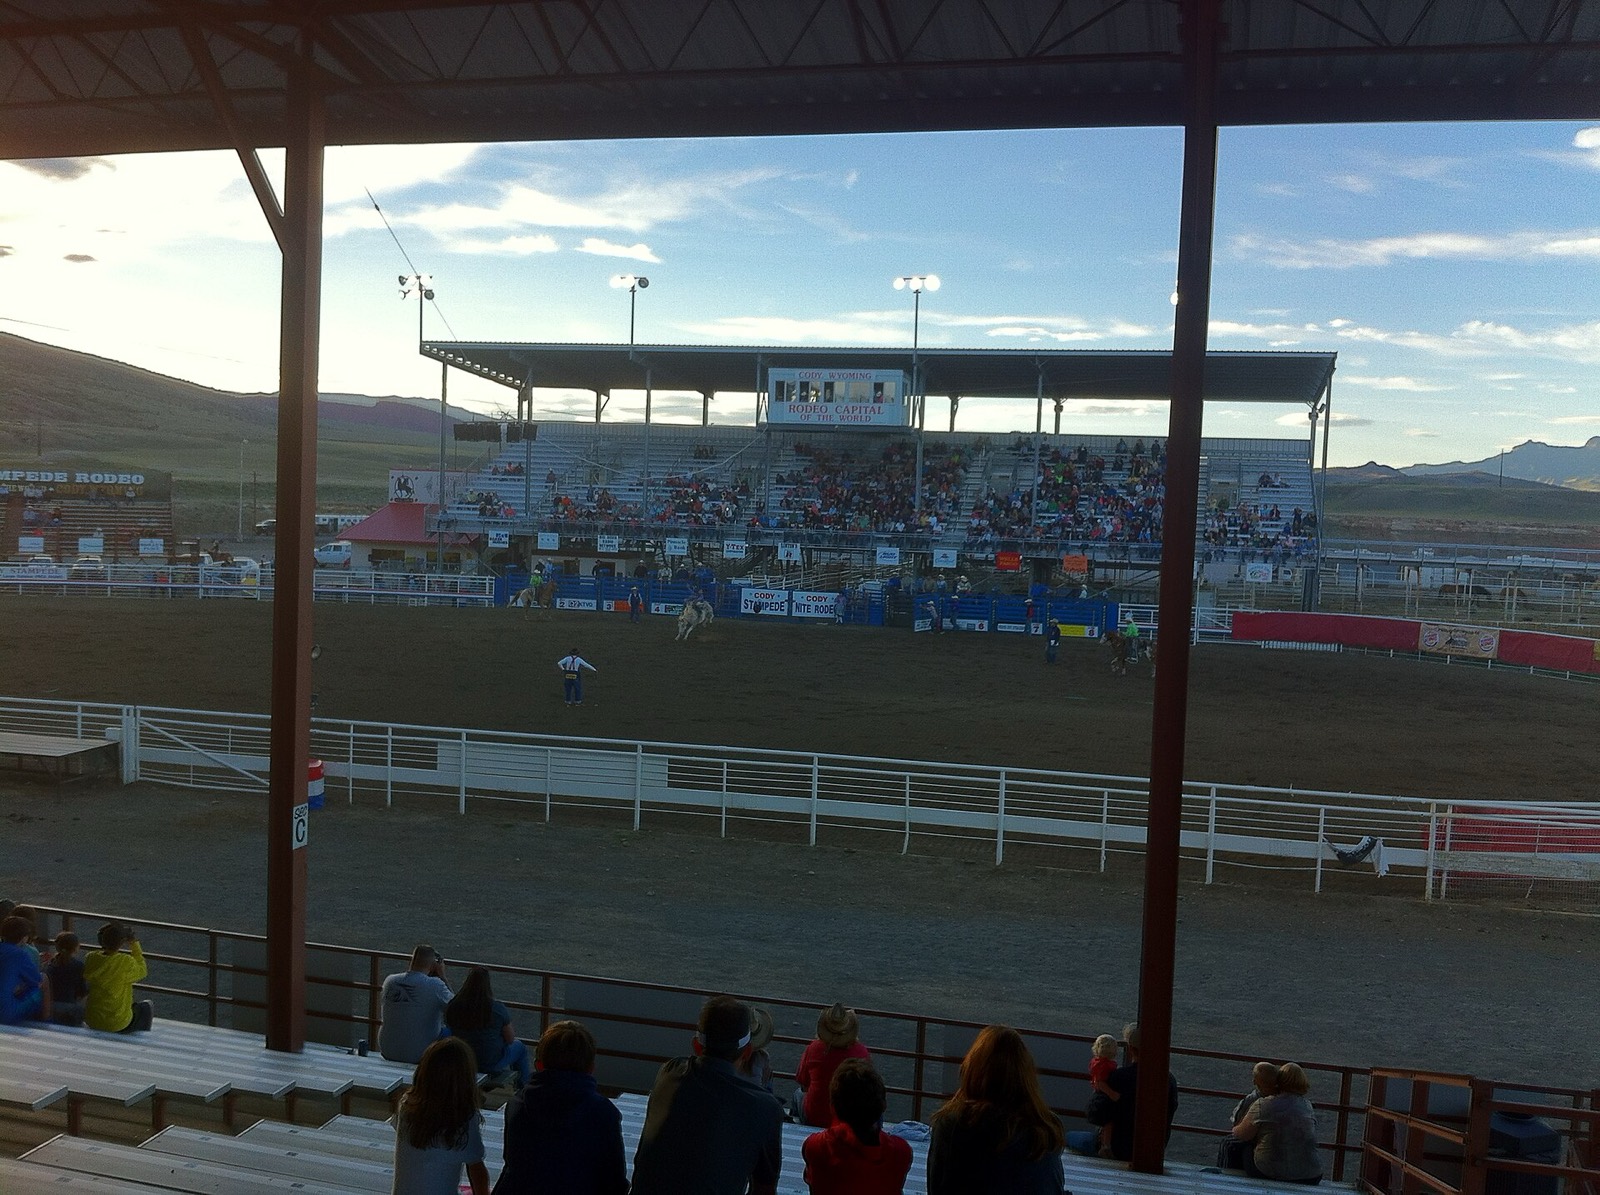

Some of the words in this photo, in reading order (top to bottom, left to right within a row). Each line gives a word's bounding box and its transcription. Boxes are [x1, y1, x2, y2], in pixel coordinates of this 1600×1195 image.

[798, 371, 823, 379] CODY
[828, 372, 872, 380] WYOMING
[788, 404, 828, 414] RODEO
[834, 406, 884, 415] CAPITAL
[75, 472, 145, 485] RODEO
[754, 592, 776, 600] CODY
[606, 603, 612, 611] 3
[654, 605, 660, 613] 4
[795, 601, 811, 614] NITE
[814, 603, 837, 615] RODE
[295, 818, 306, 843] C
